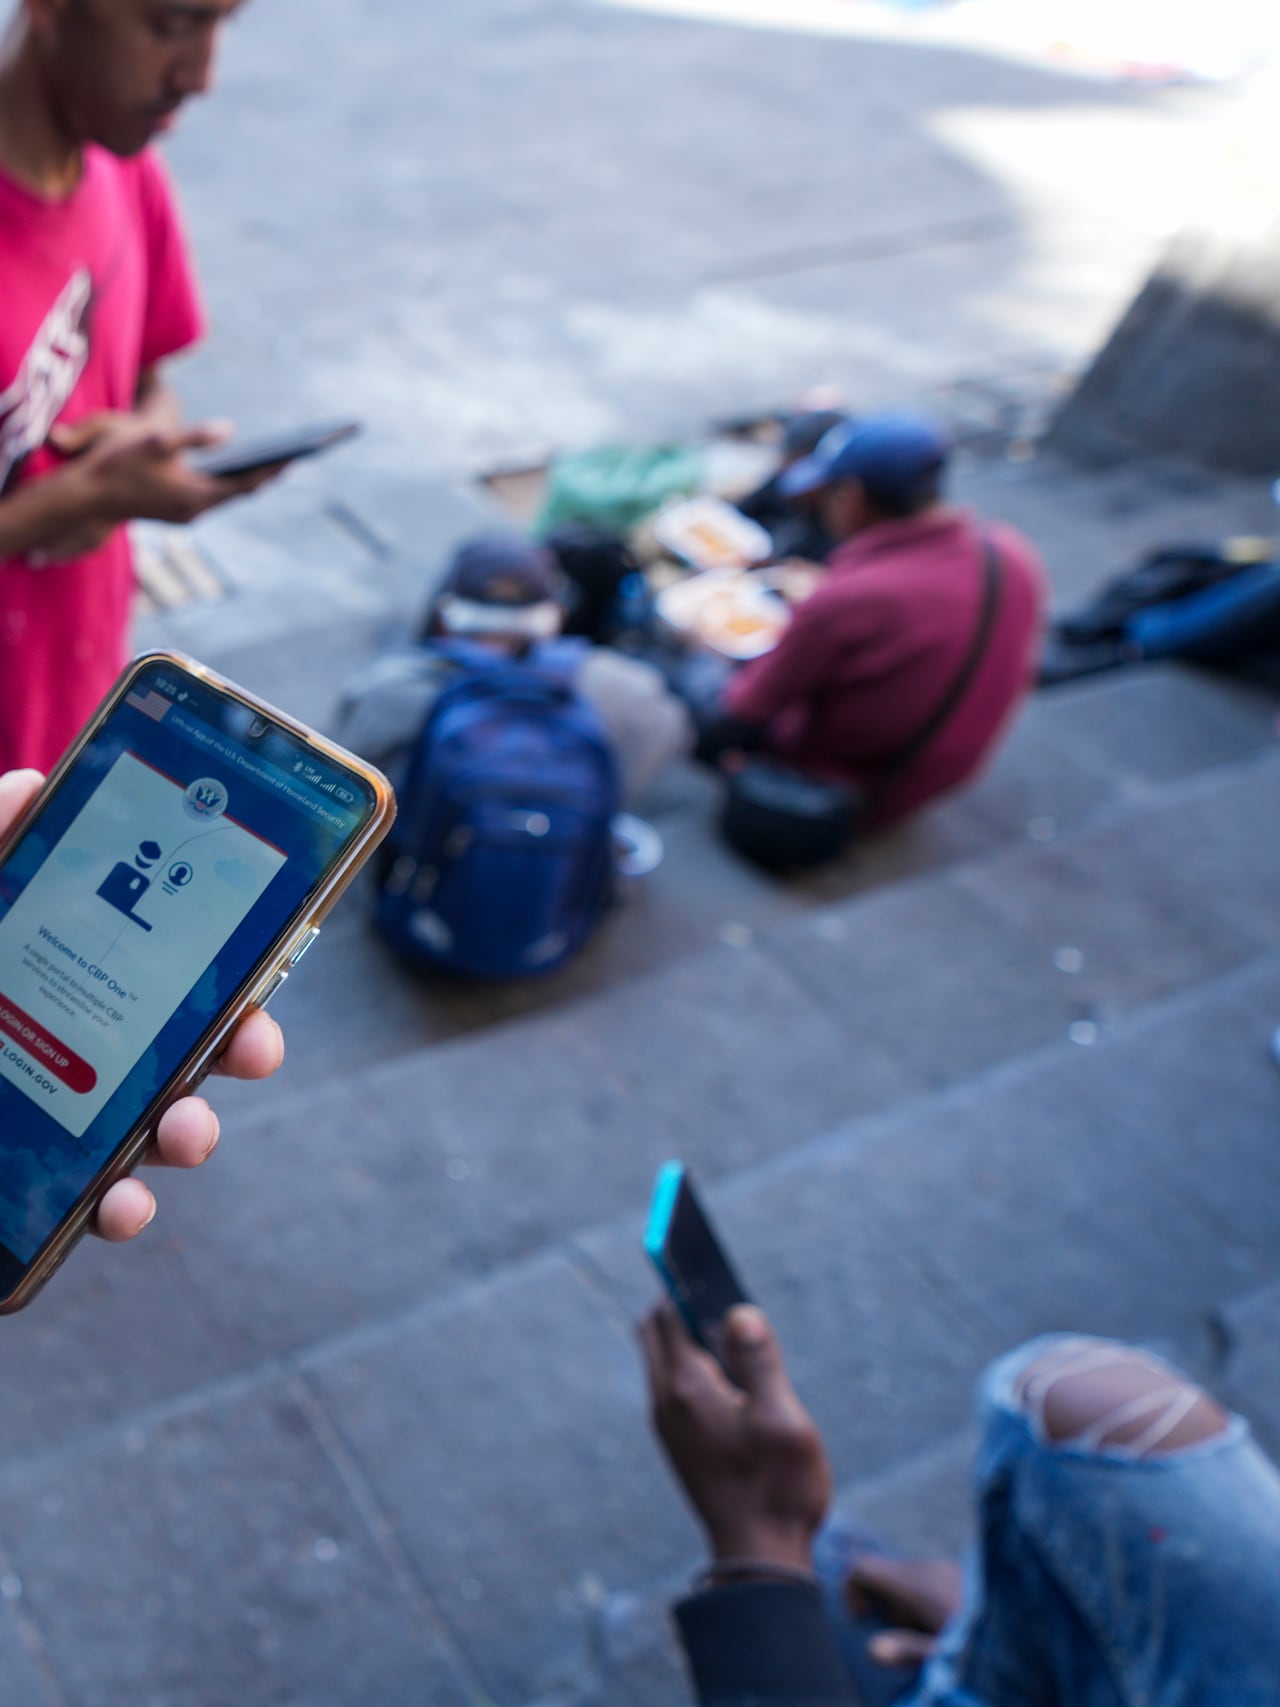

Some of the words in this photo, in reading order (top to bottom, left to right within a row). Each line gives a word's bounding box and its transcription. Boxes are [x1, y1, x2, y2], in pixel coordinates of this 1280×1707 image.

[193, 729, 207, 743] App
[236, 755, 277, 785] Department
[283, 784, 318, 811] Homeland
[316, 806, 346, 829] Security
[22, 956, 49, 982] services
[47, 977, 59, 988] to
[56, 985, 93, 1015] streamline
[90, 1012, 110, 1028] your
[23, 943, 31, 952] A
[29, 949, 50, 967] single
[47, 963, 72, 983] portal
[69, 978, 80, 991] to
[78, 985, 108, 1012] multiple
[105, 1006, 125, 1022] CBP
[38, 923, 78, 961] Welcome
[76, 956, 88, 969] to
[87, 964, 110, 983] CBP
[107, 979, 128, 999] One
[2, 1047, 59, 1095] LOGIN.GOV
[20, 1026, 37, 1043] OR
[33, 1037, 58, 1060] SIGN
[53, 1053, 71, 1068] UP
